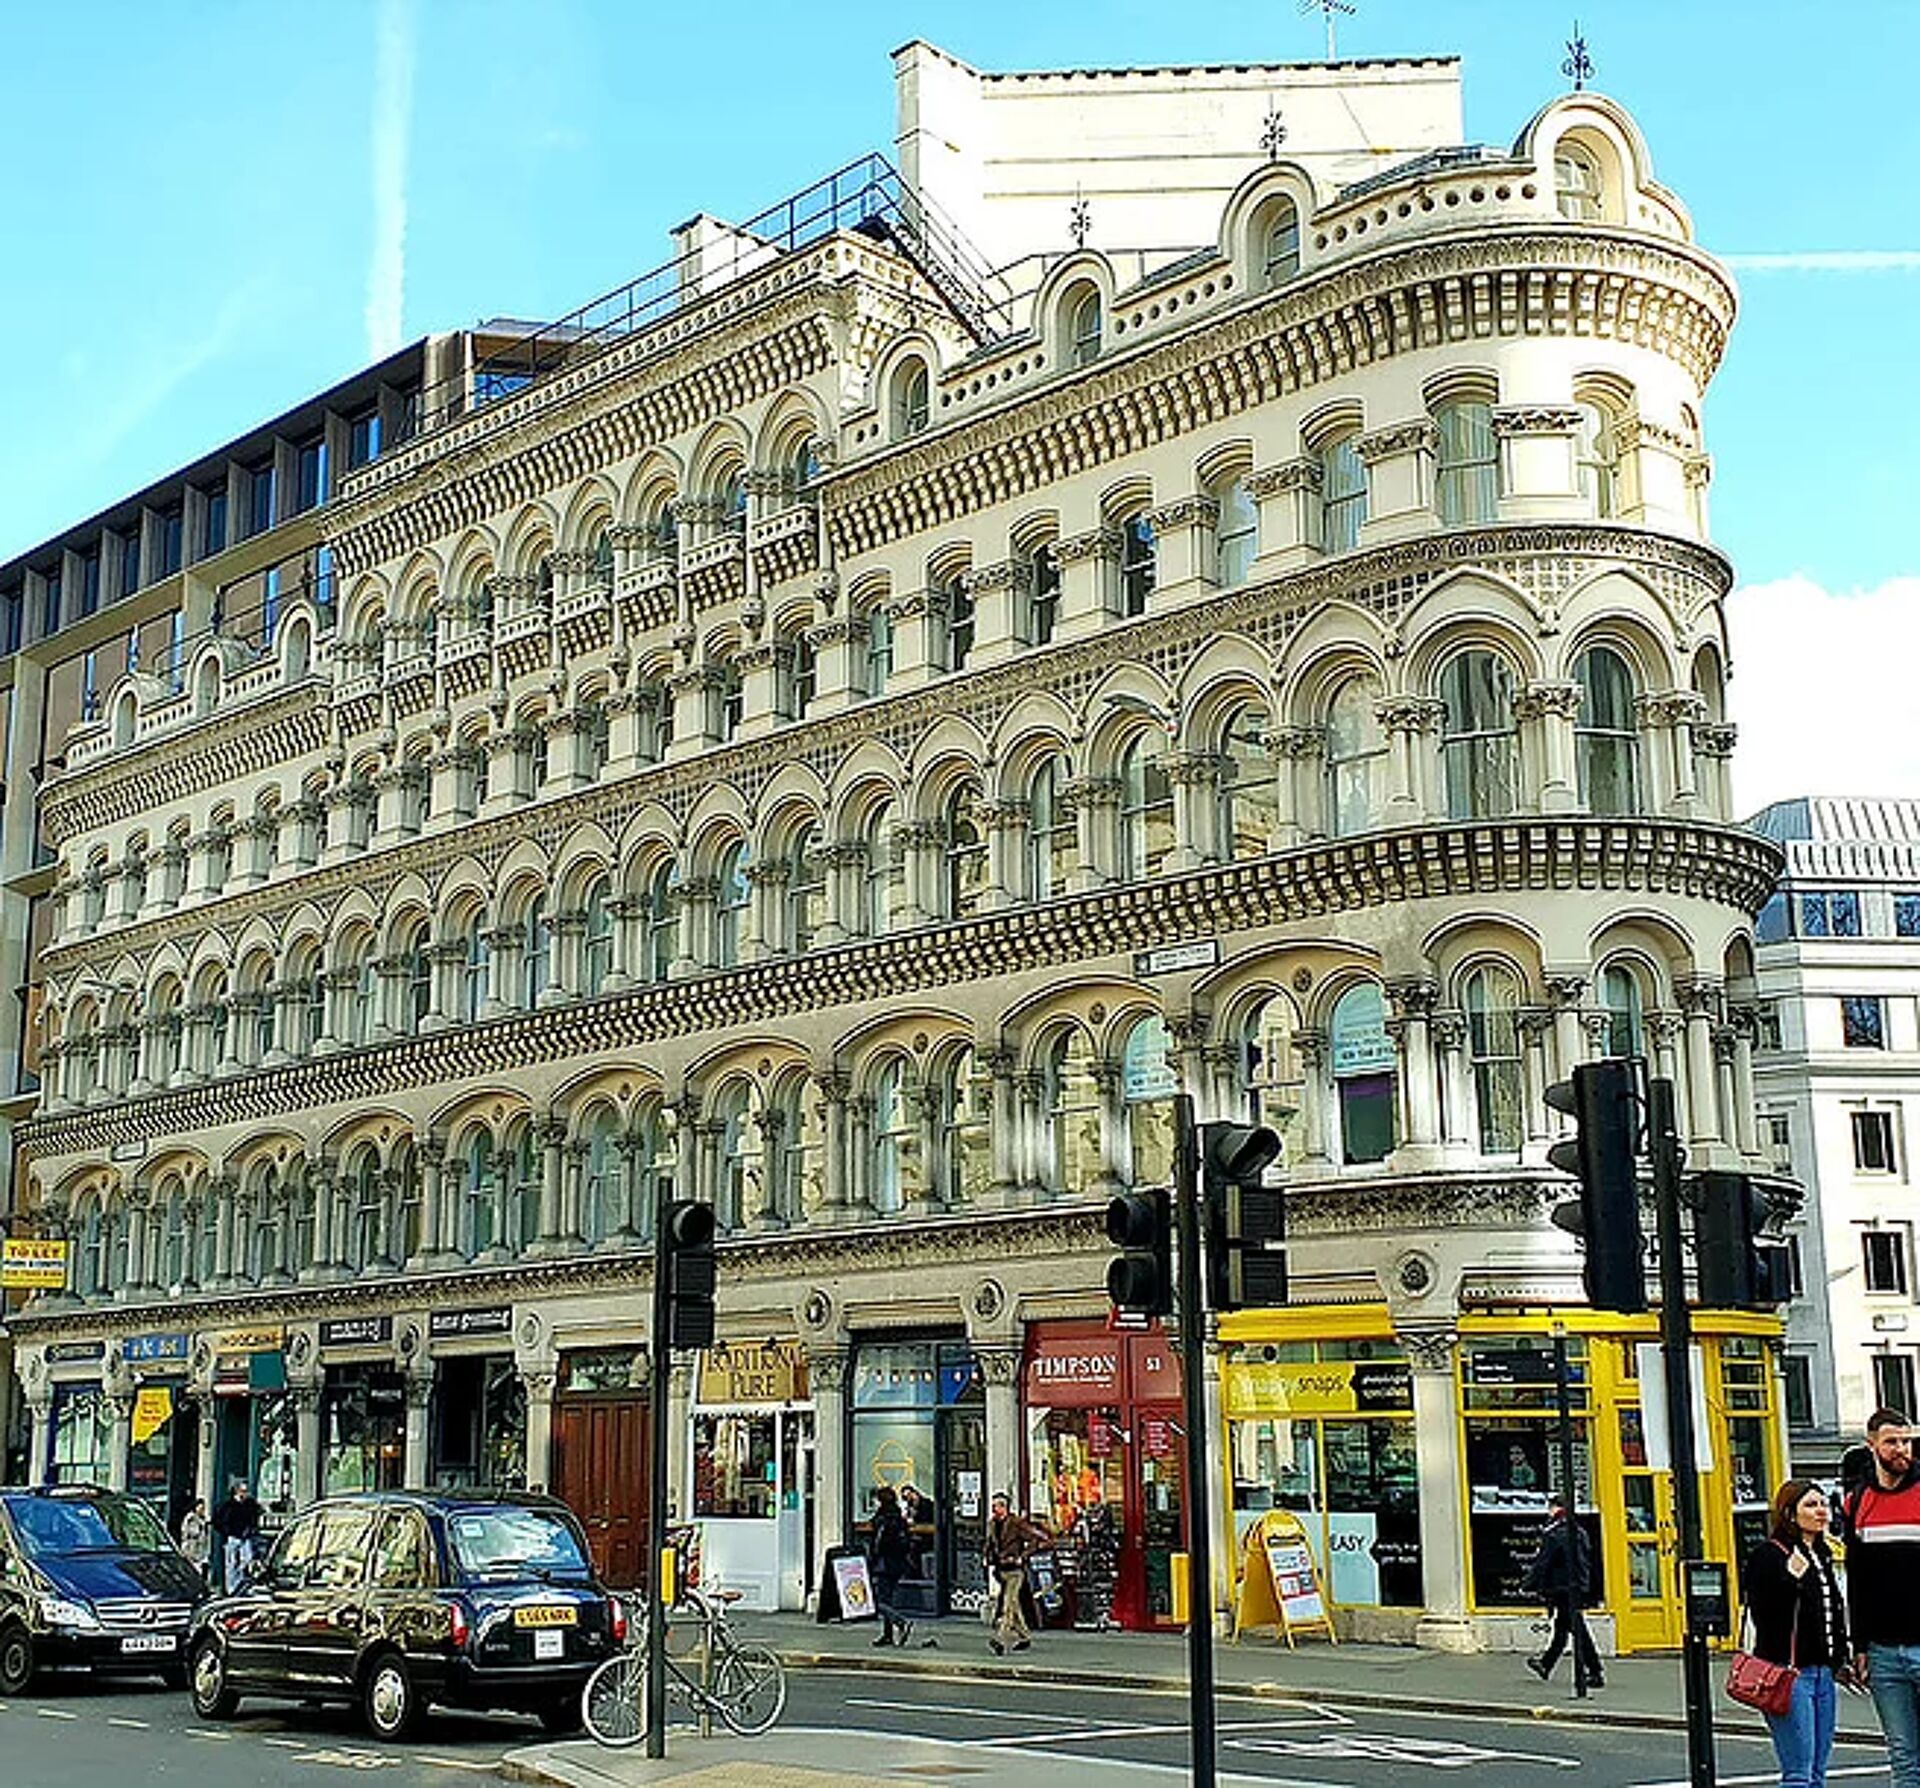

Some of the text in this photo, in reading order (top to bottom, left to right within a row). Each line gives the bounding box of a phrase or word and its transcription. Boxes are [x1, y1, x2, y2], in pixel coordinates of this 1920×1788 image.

[10, 1246, 30, 1258] TO
[1034, 1354, 1116, 1376] TIMPSON
[731, 1372, 776, 1397] PURE
[1297, 1375, 1344, 1398] snaps
